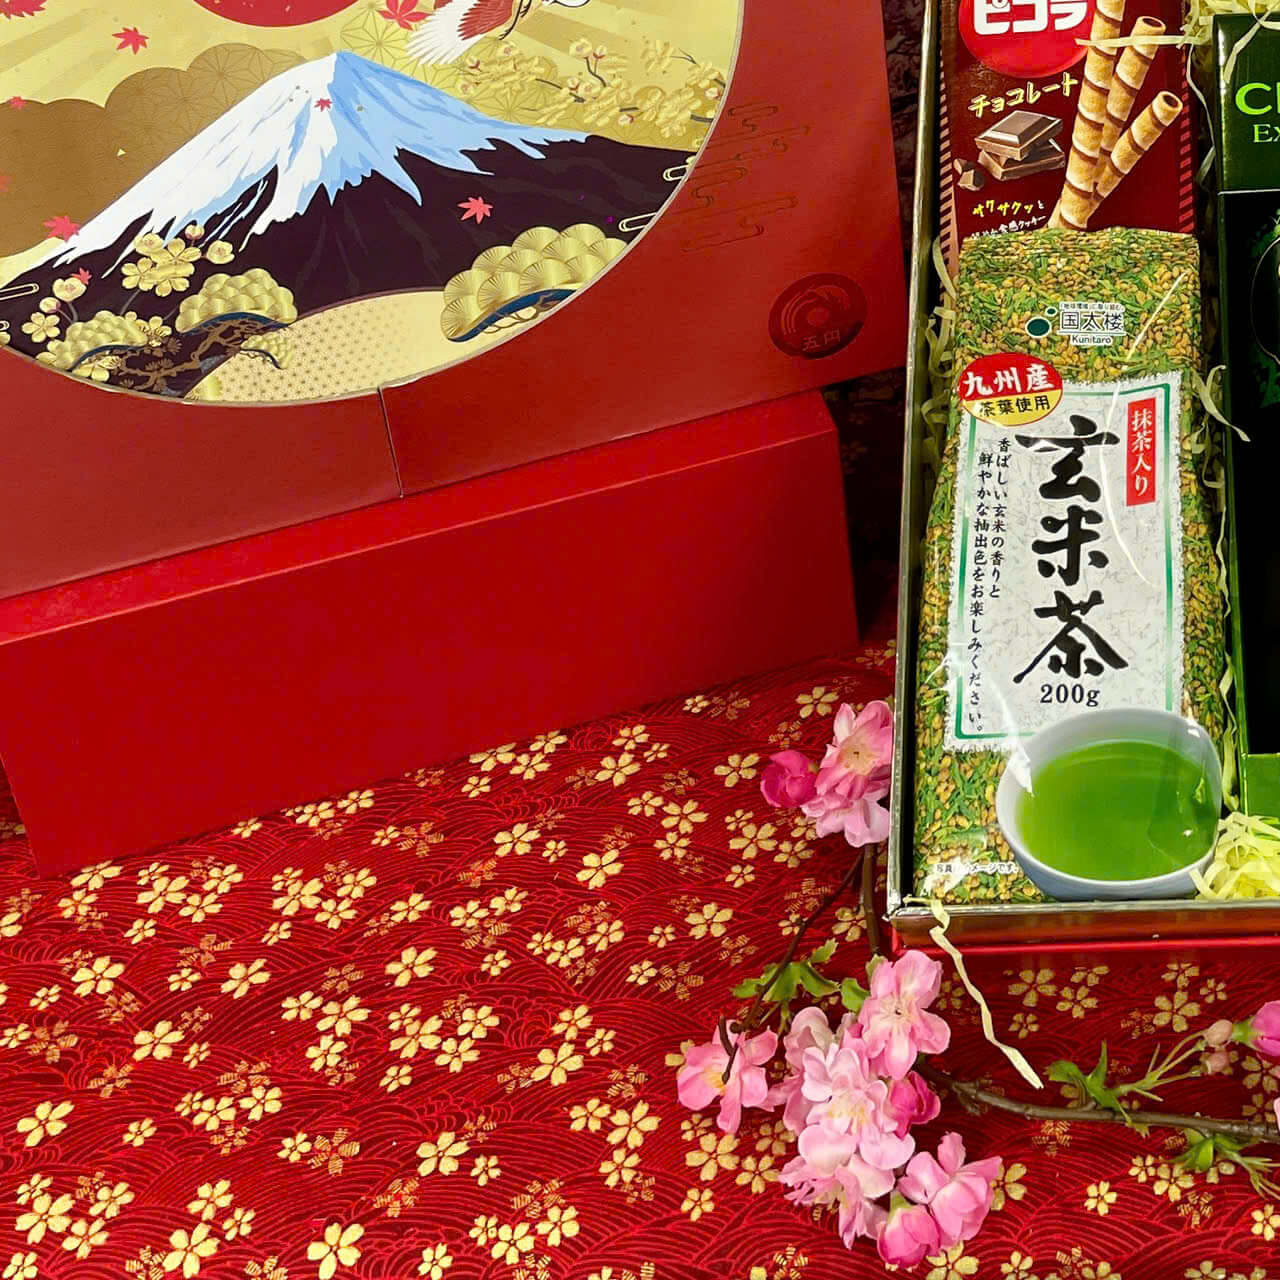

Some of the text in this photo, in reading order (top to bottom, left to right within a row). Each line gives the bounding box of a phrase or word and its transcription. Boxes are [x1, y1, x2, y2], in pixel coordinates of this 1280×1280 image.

[969, 71, 1078, 118] チョコレート
[1061, 311, 1123, 330] 国太楼
[1072, 335, 1112, 344] Kunitaro
[963, 364, 1054, 397] 九州産
[980, 394, 1051, 418] 茶葉使用
[1131, 407, 1153, 496] 抹茶入り
[988, 437, 1012, 598] 香ばしい玄米の香りと
[1013, 415, 1128, 684] 玄米茶
[967, 452, 994, 732] 鮮やかな抽出色をお楽しみください。
[1040, 683, 1101, 707] 200g
